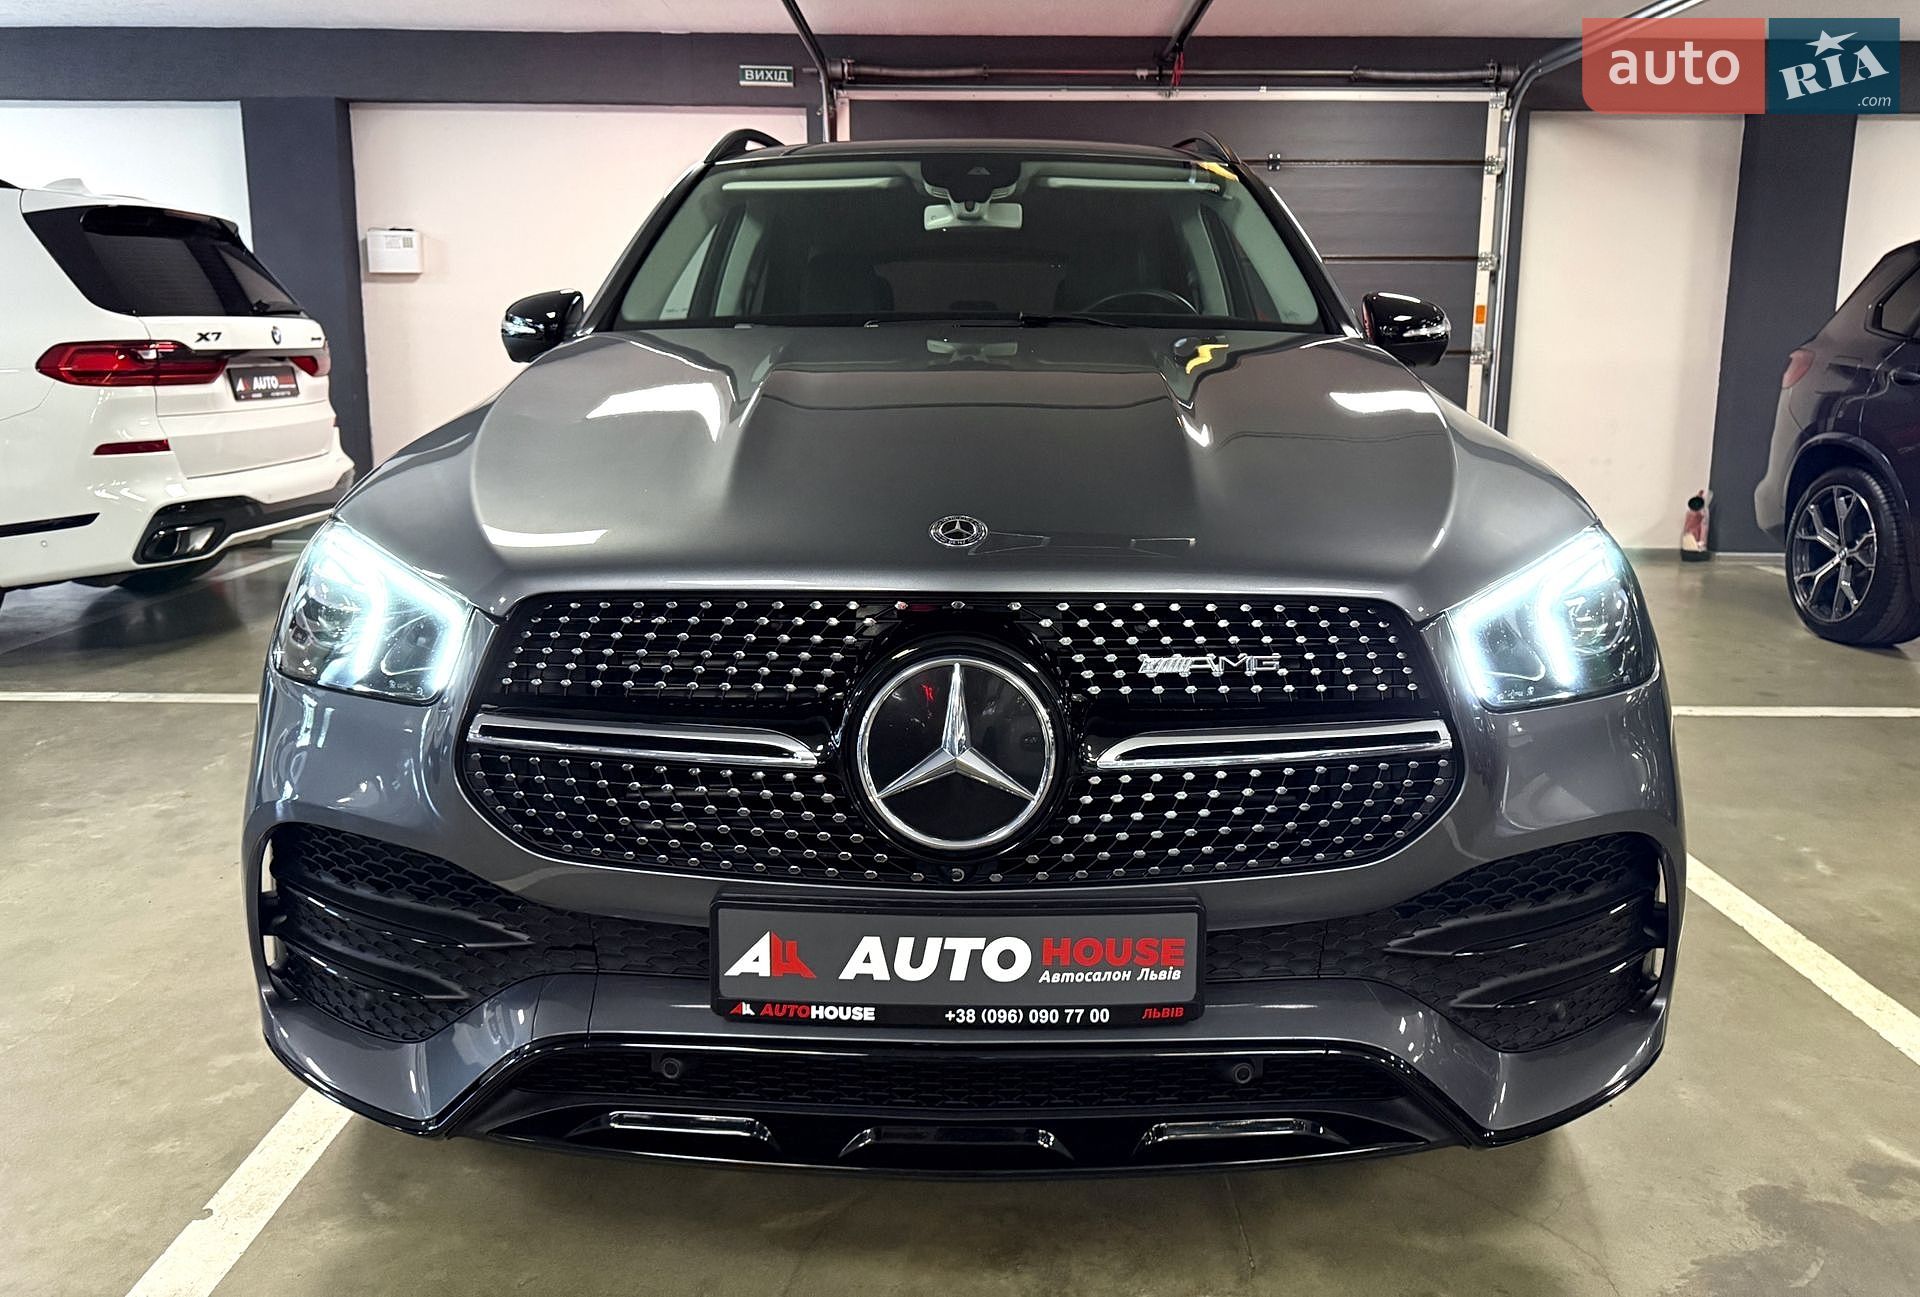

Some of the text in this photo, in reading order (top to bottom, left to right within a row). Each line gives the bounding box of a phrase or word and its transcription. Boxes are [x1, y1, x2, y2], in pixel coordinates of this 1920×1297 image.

[745, 69, 788, 82] ВИХІД
[195, 332, 222, 343] X7
[253, 376, 279, 391] AUTO
[1187, 655, 1281, 673] AMG
[838, 936, 1032, 983] AUTO
[1042, 937, 1186, 967] HOUSE
[1039, 966, 1182, 984] Автосалон Львів
[945, 1008, 1110, 1024] +38 (096) 090 77 00
[1142, 1007, 1185, 1020] ЛЬВІВ
